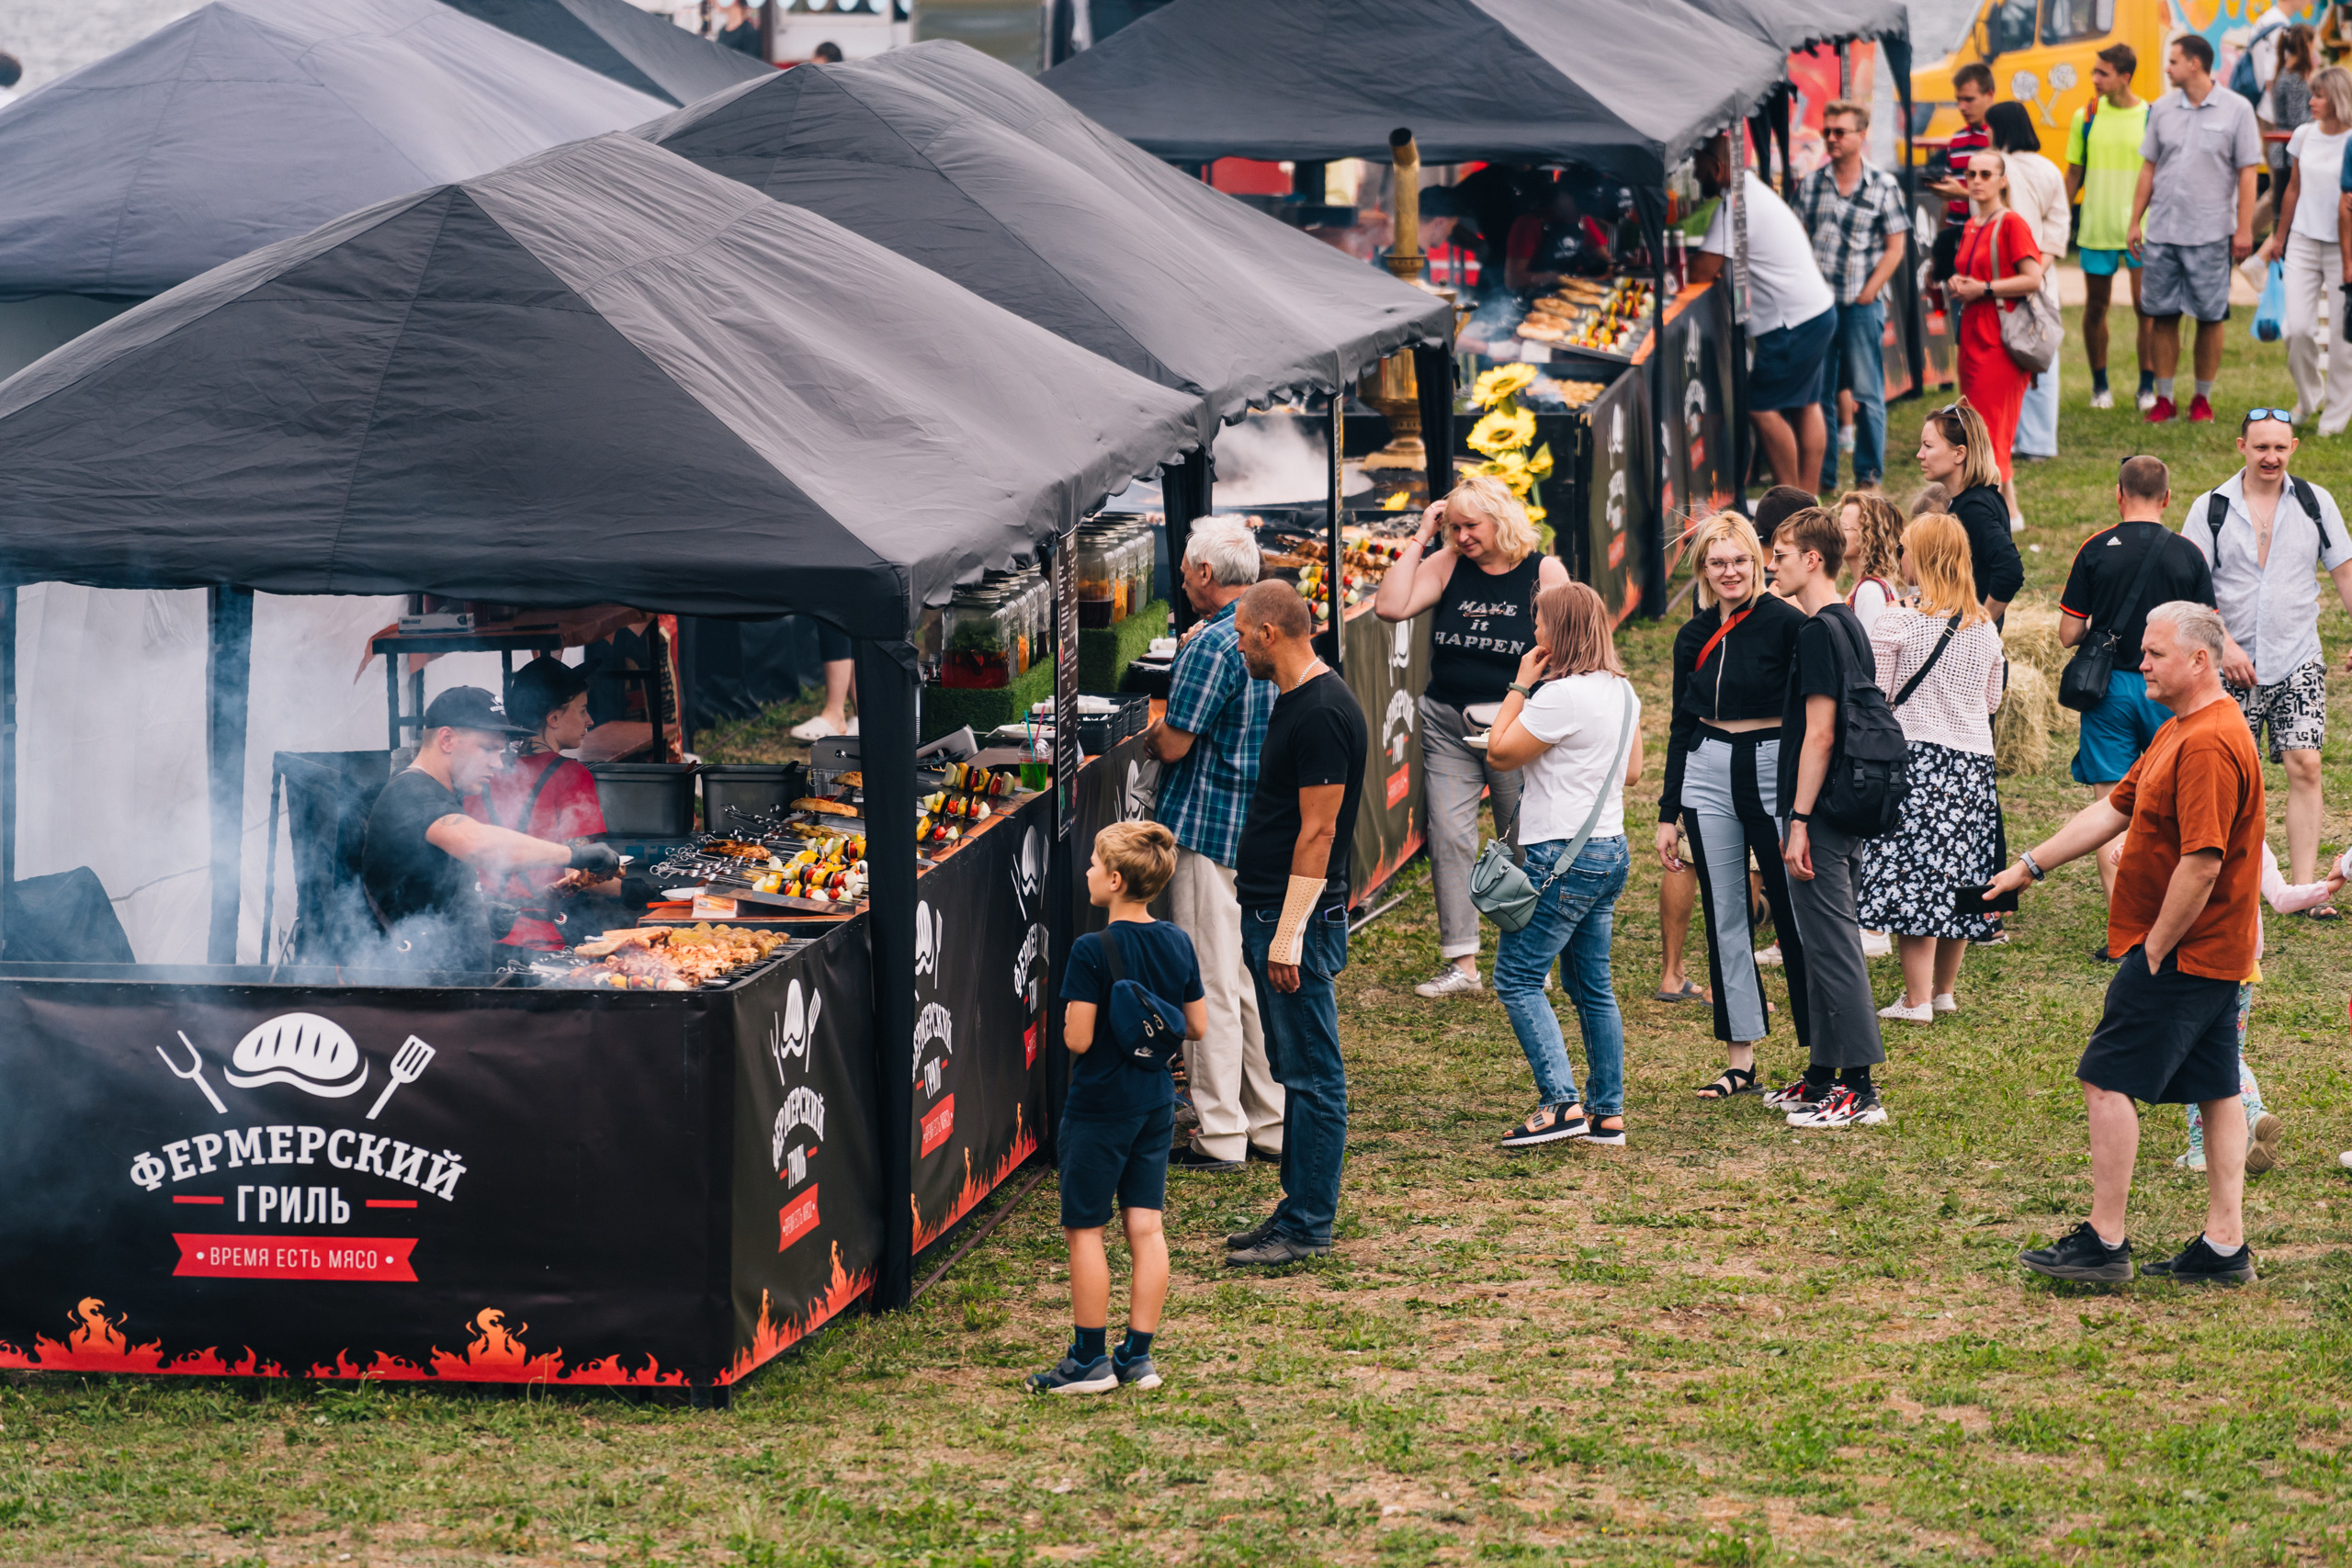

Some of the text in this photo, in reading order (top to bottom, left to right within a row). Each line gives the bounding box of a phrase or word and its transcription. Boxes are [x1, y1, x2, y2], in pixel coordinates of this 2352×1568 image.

[1457, 600, 1518, 616] MAKE
[1470, 619, 1489, 632] it
[1435, 631, 1525, 655] HAPPEN
[130, 1125, 467, 1201] ФЕРМЕРСКИЙ
[237, 1185, 350, 1224] ГРИЛЬ
[209, 1247, 378, 1269] ВРЕМЯ ЕСТЬ МЯСО
